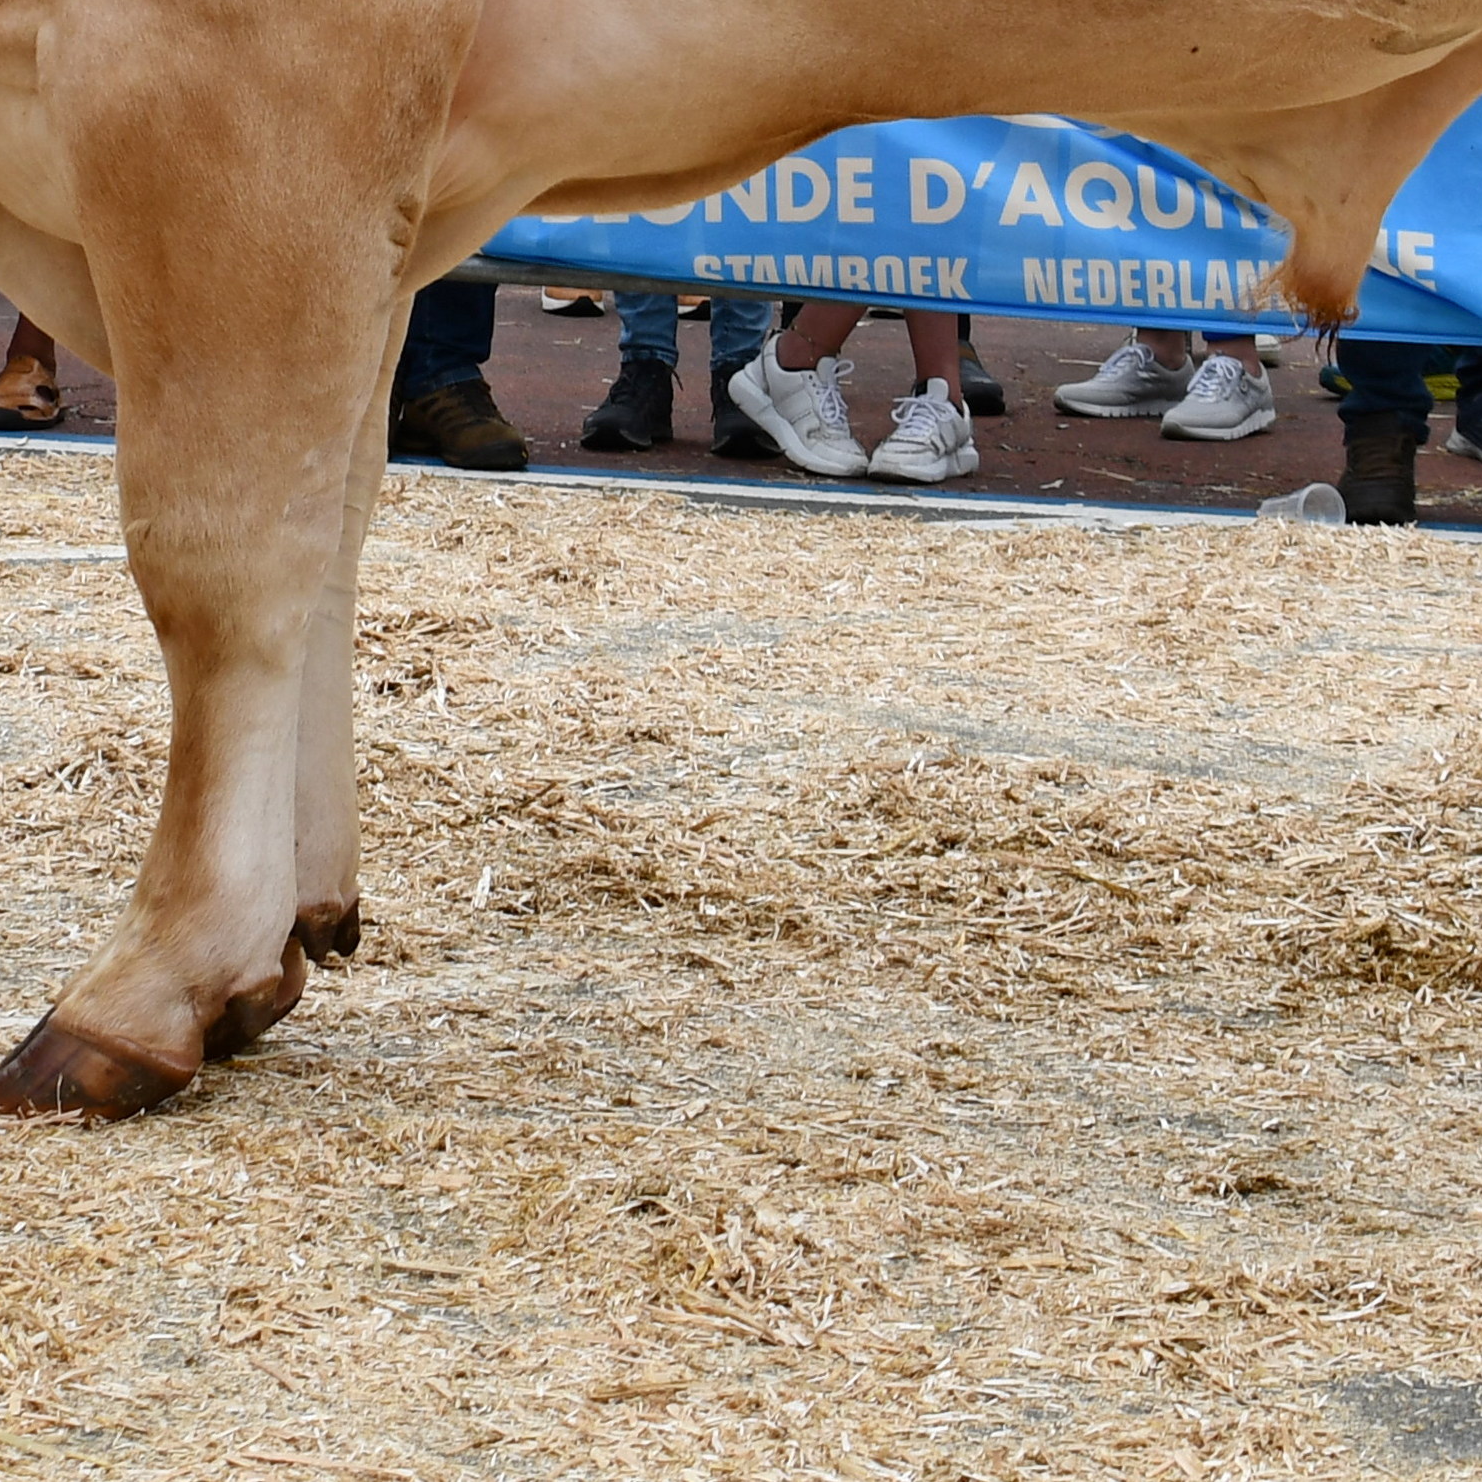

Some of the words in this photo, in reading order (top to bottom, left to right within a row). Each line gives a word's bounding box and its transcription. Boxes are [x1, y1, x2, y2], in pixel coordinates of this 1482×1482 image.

[541, 157, 875, 225] NDE
[692, 254, 972, 300] STAMBOEK
[1023, 258, 1291, 312] NEDERLAN
